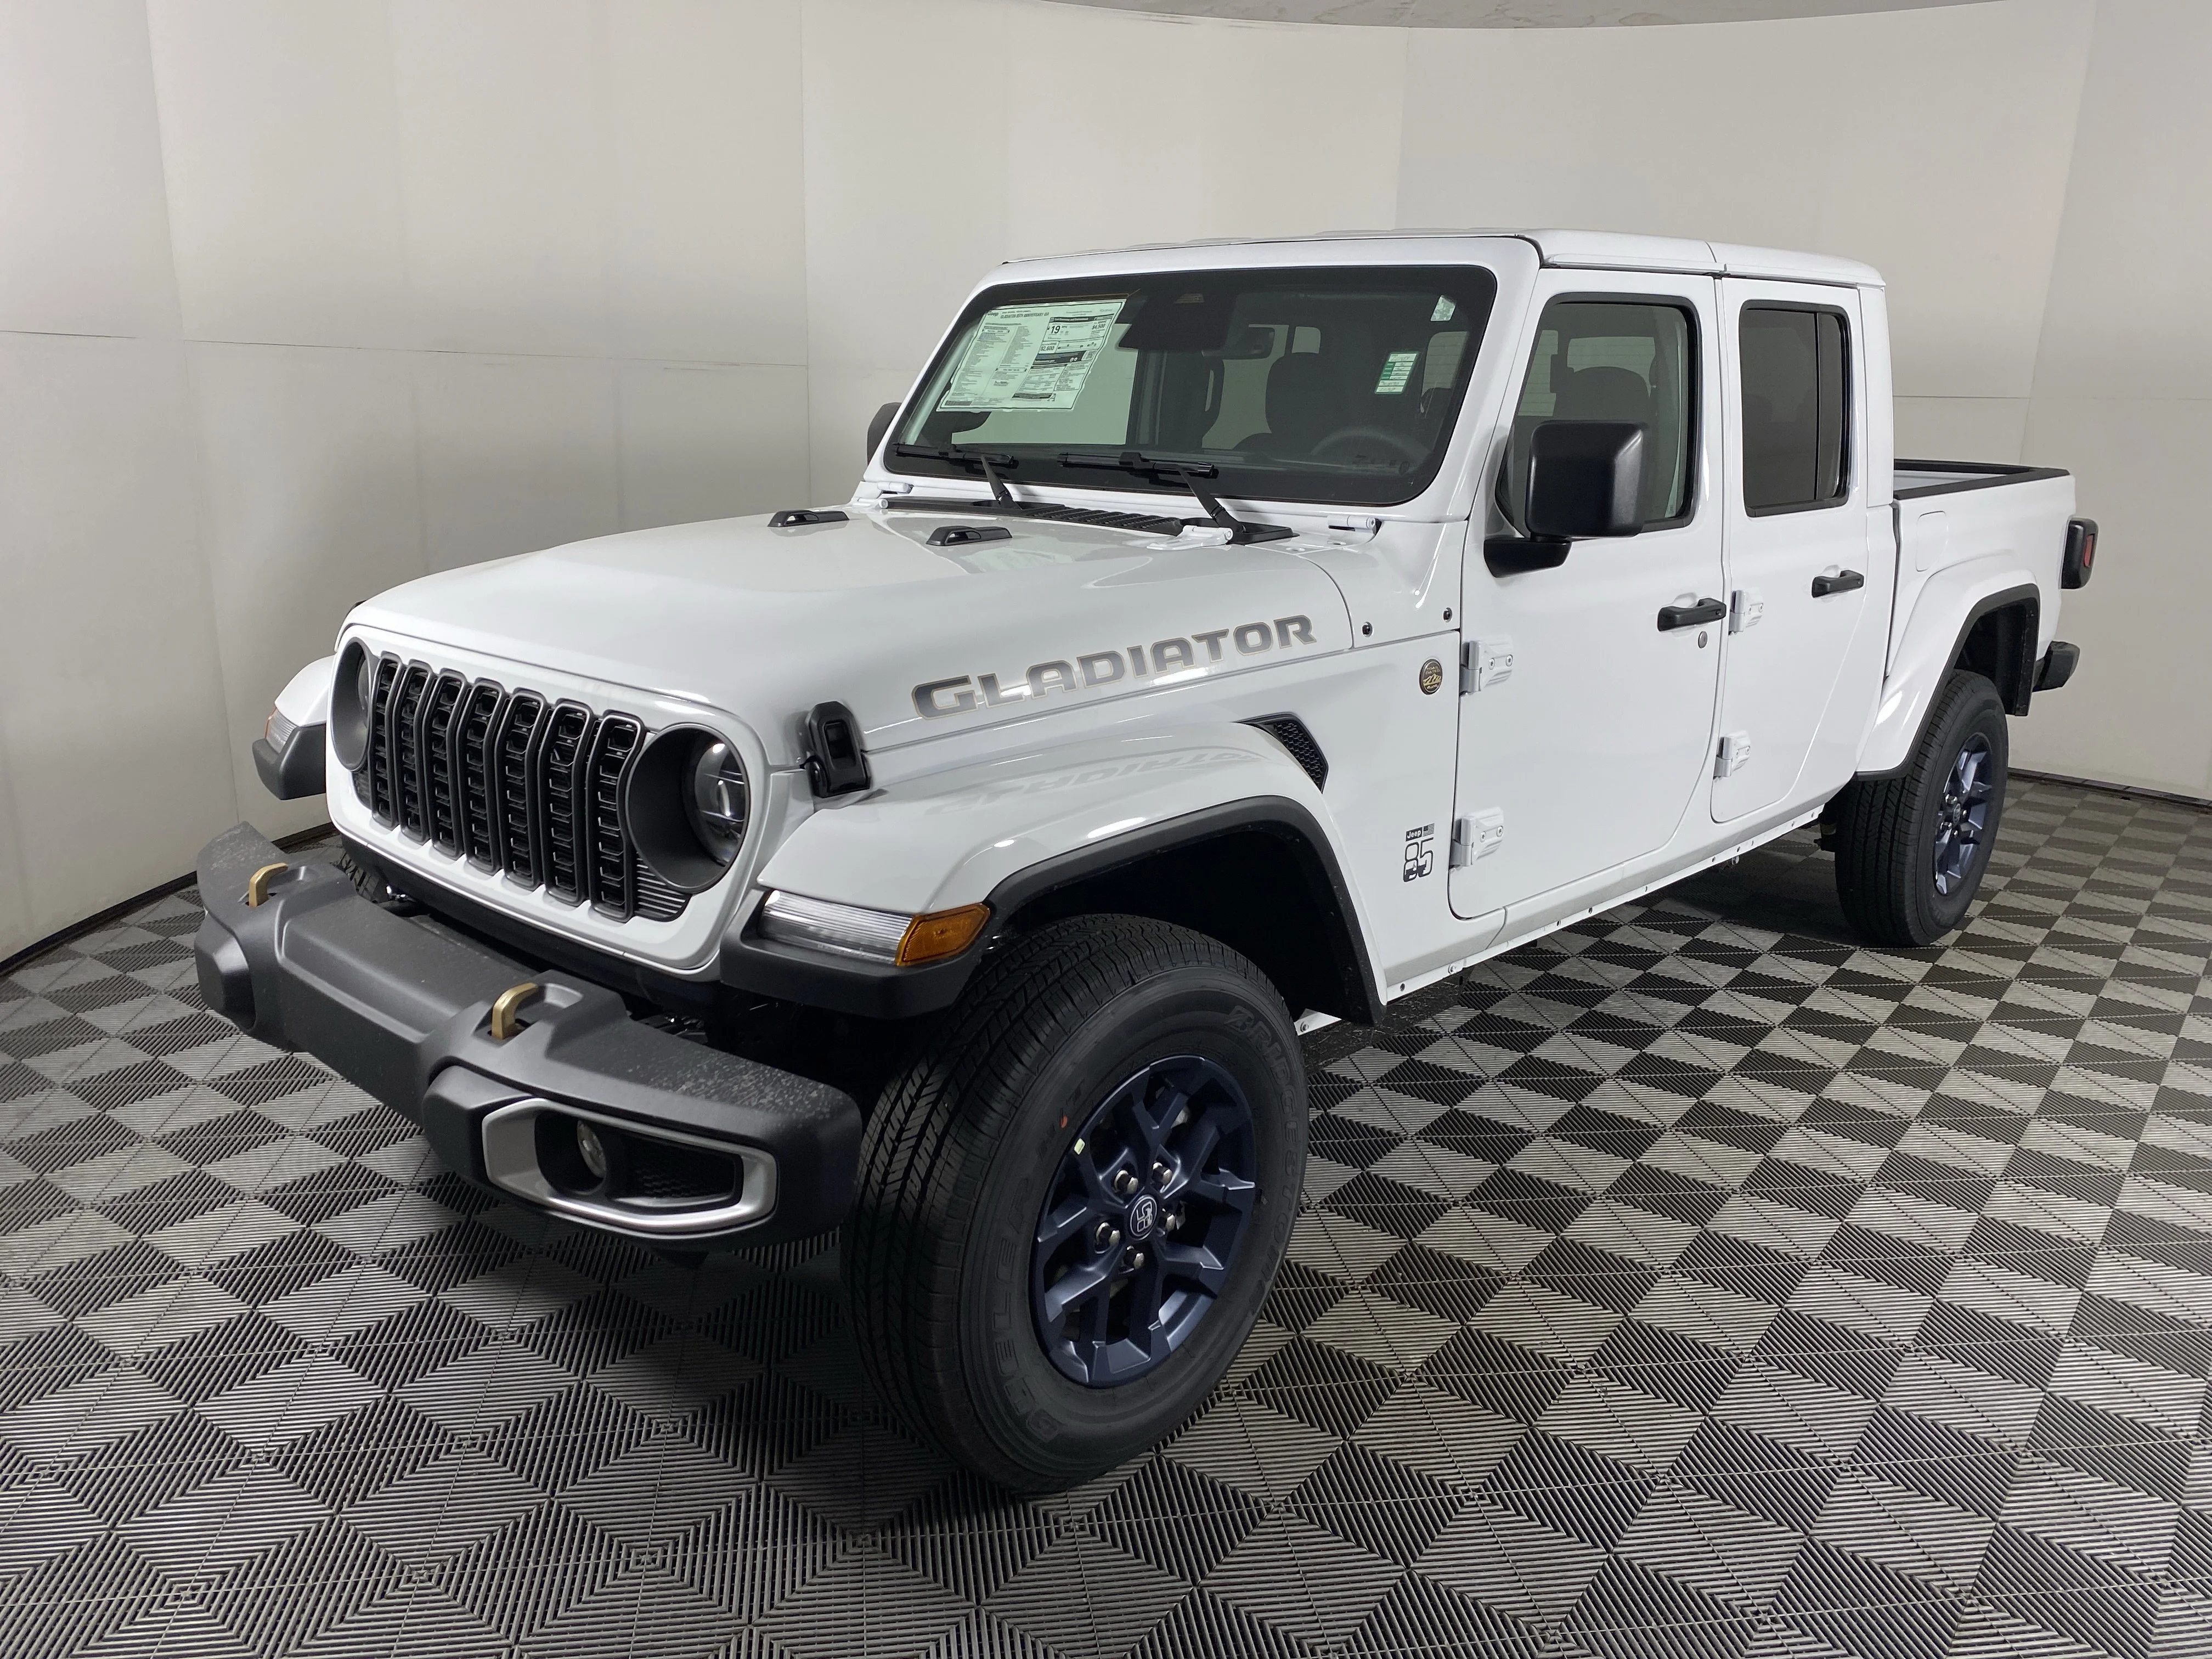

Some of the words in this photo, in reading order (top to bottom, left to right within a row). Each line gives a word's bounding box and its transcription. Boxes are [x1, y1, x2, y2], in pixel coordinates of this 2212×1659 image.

[1051, 325, 1060, 334] 19
[911, 614, 1318, 720] GLADIATOR
[1403, 837, 1434, 882] 85
[1407, 830, 1421, 839] Jeep
[1223, 1004, 1301, 1317] BRIDGESTONE
[992, 1176, 1060, 1443] DUELER
